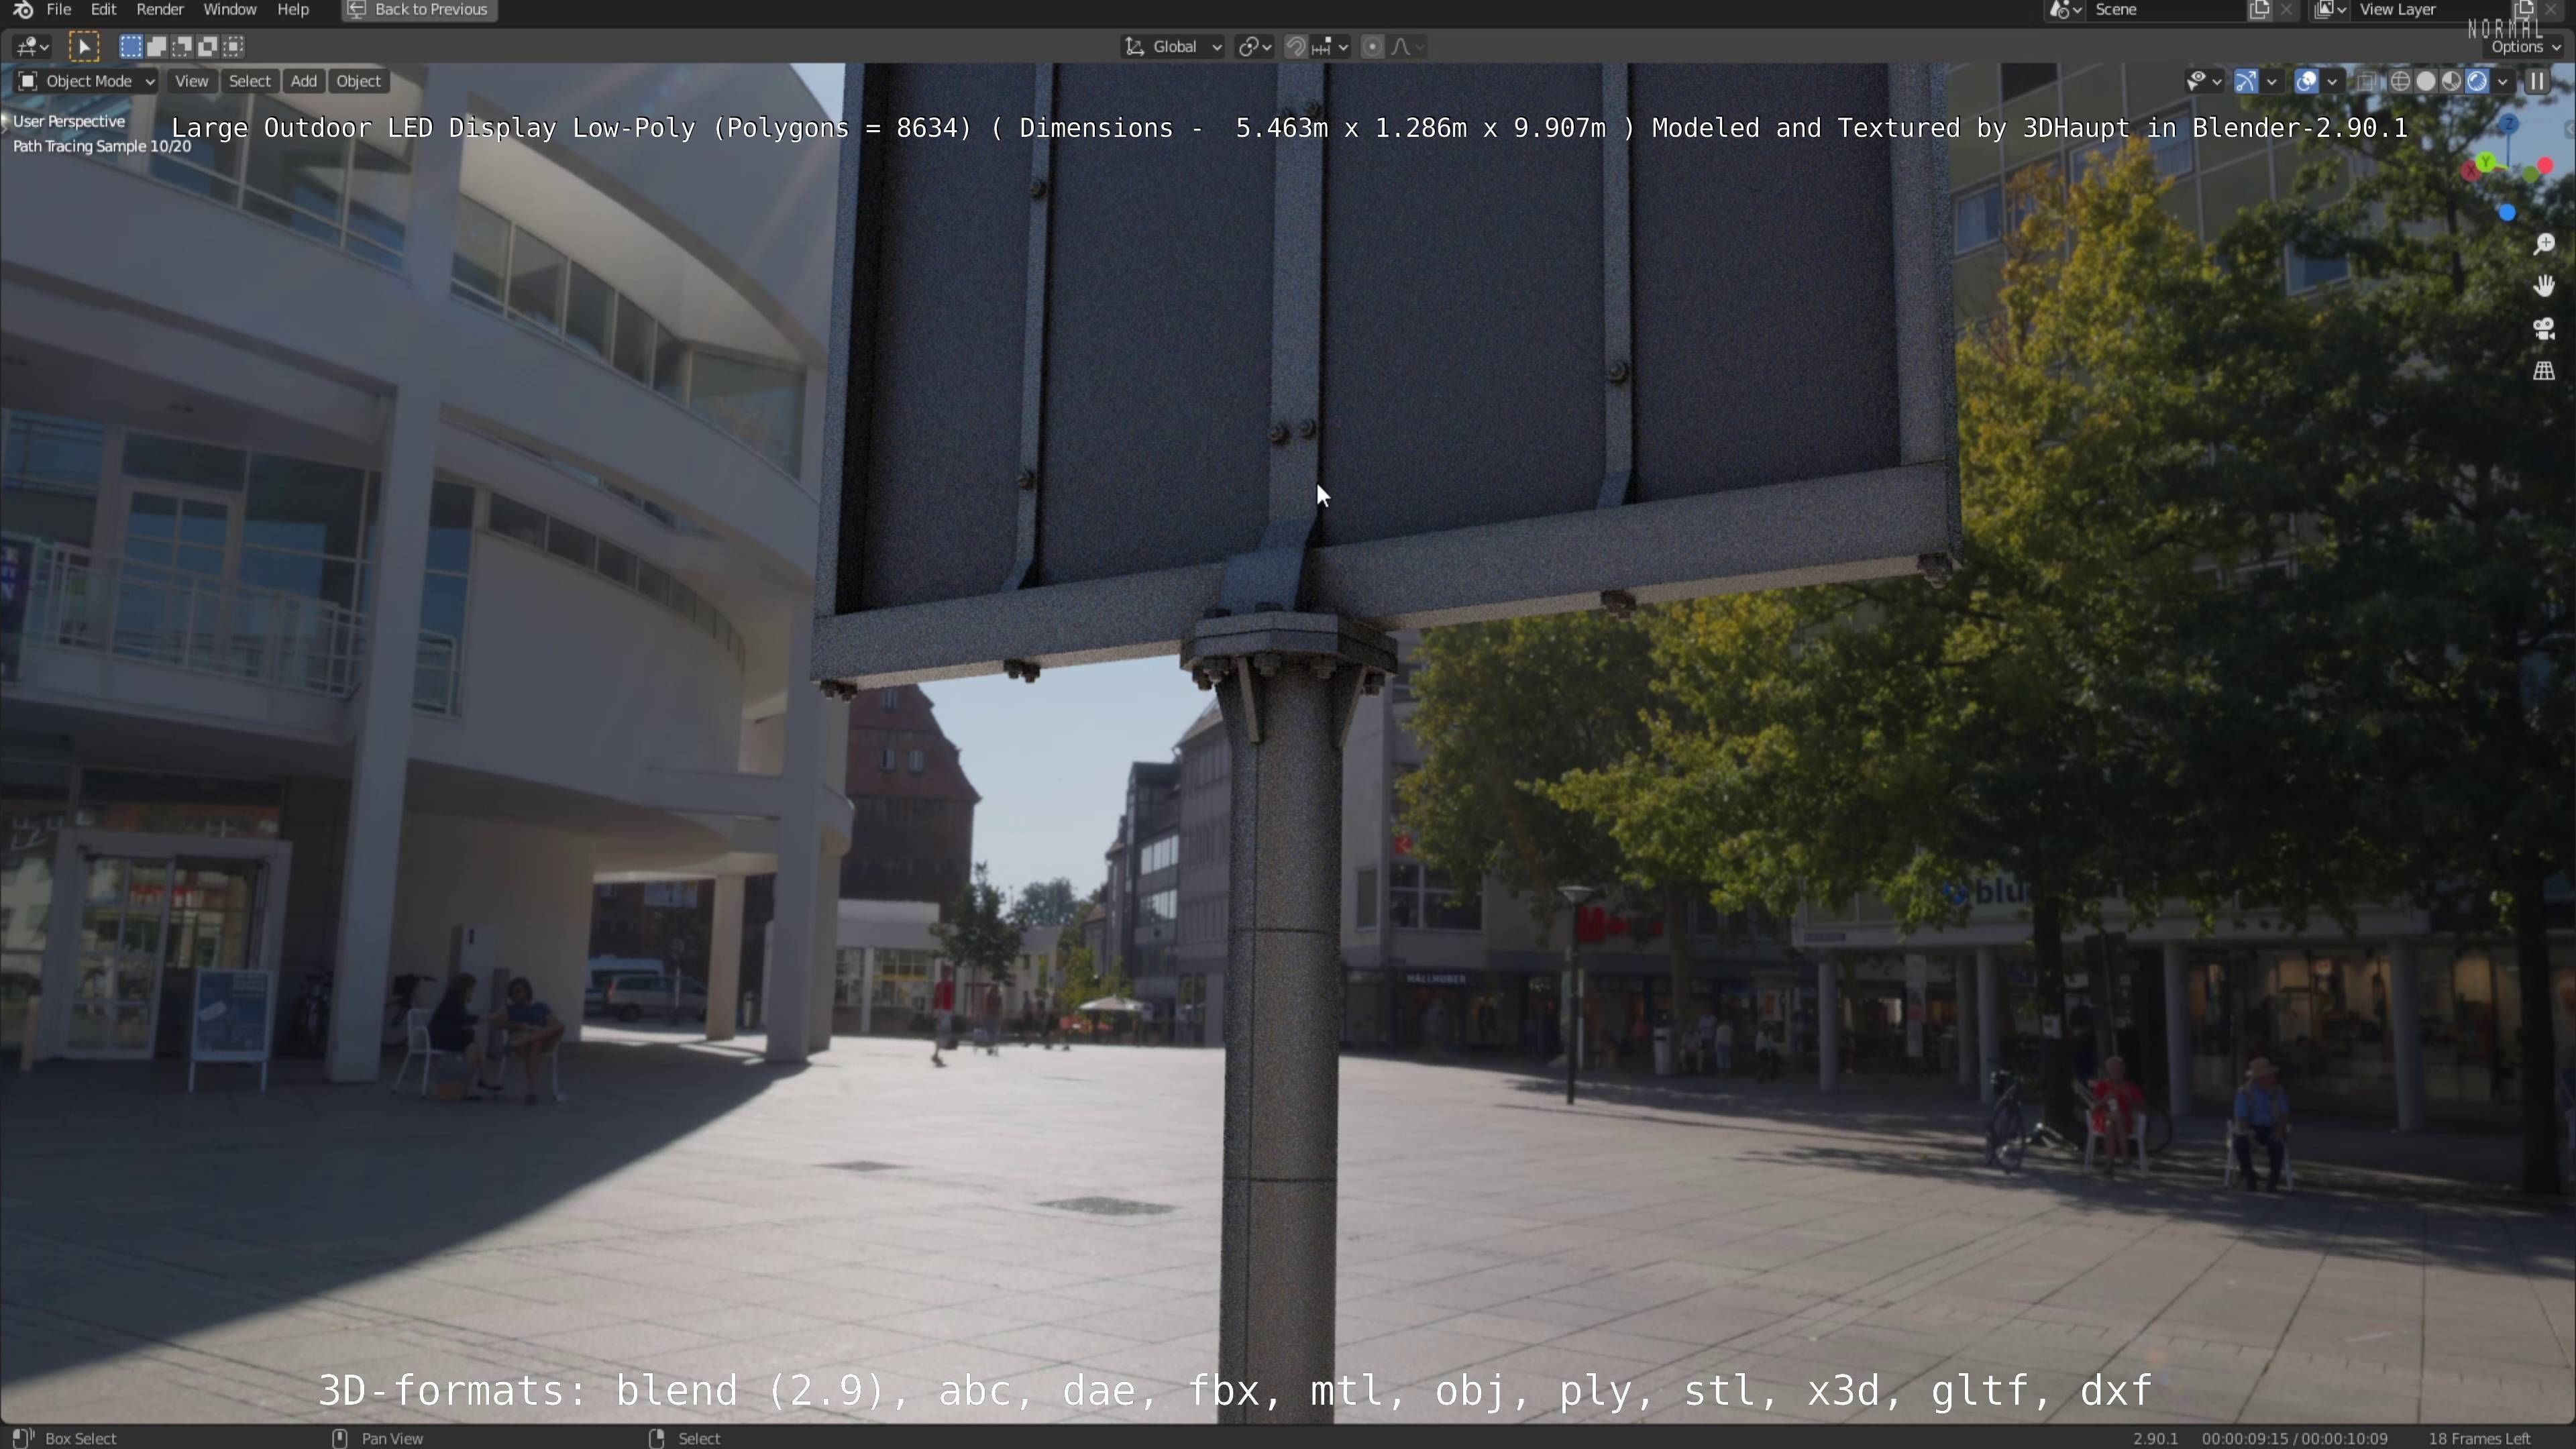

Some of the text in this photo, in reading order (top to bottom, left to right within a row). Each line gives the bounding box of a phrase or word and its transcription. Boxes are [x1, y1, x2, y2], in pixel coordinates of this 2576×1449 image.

[47, 3, 72, 15] File
[91, 3, 117, 15] Edit
[137, 3, 184, 15] Render
[204, 3, 257, 15] Window
[278, 3, 309, 19] Help
[376, 2, 488, 15] Back to Previous
[2096, 3, 2137, 15] Scene
[2360, 3, 2436, 18] View Layer
[1154, 40, 1196, 53] Global
[2492, 40, 2544, 56] Options
[47, 74, 131, 90] Object Mode
[175, 74, 209, 87] View
[229, 74, 271, 87] Select
[291, 74, 317, 87] Add
[337, 74, 381, 90] Object
[13, 115, 125, 130] User Perspective
[13, 139, 191, 156] Path Tracing Sample 10/20
[46, 1432, 117, 1445] Box Select
[363, 1432, 423, 1445] Pan View
[679, 1432, 720, 1445] Select
[2134, 1432, 2178, 1445] 2.90.1
[2202, 1432, 2388, 1447] 00:00:09:15 / 00:00:10:09
[2430, 1432, 2531, 1445] 18 Frames Left
